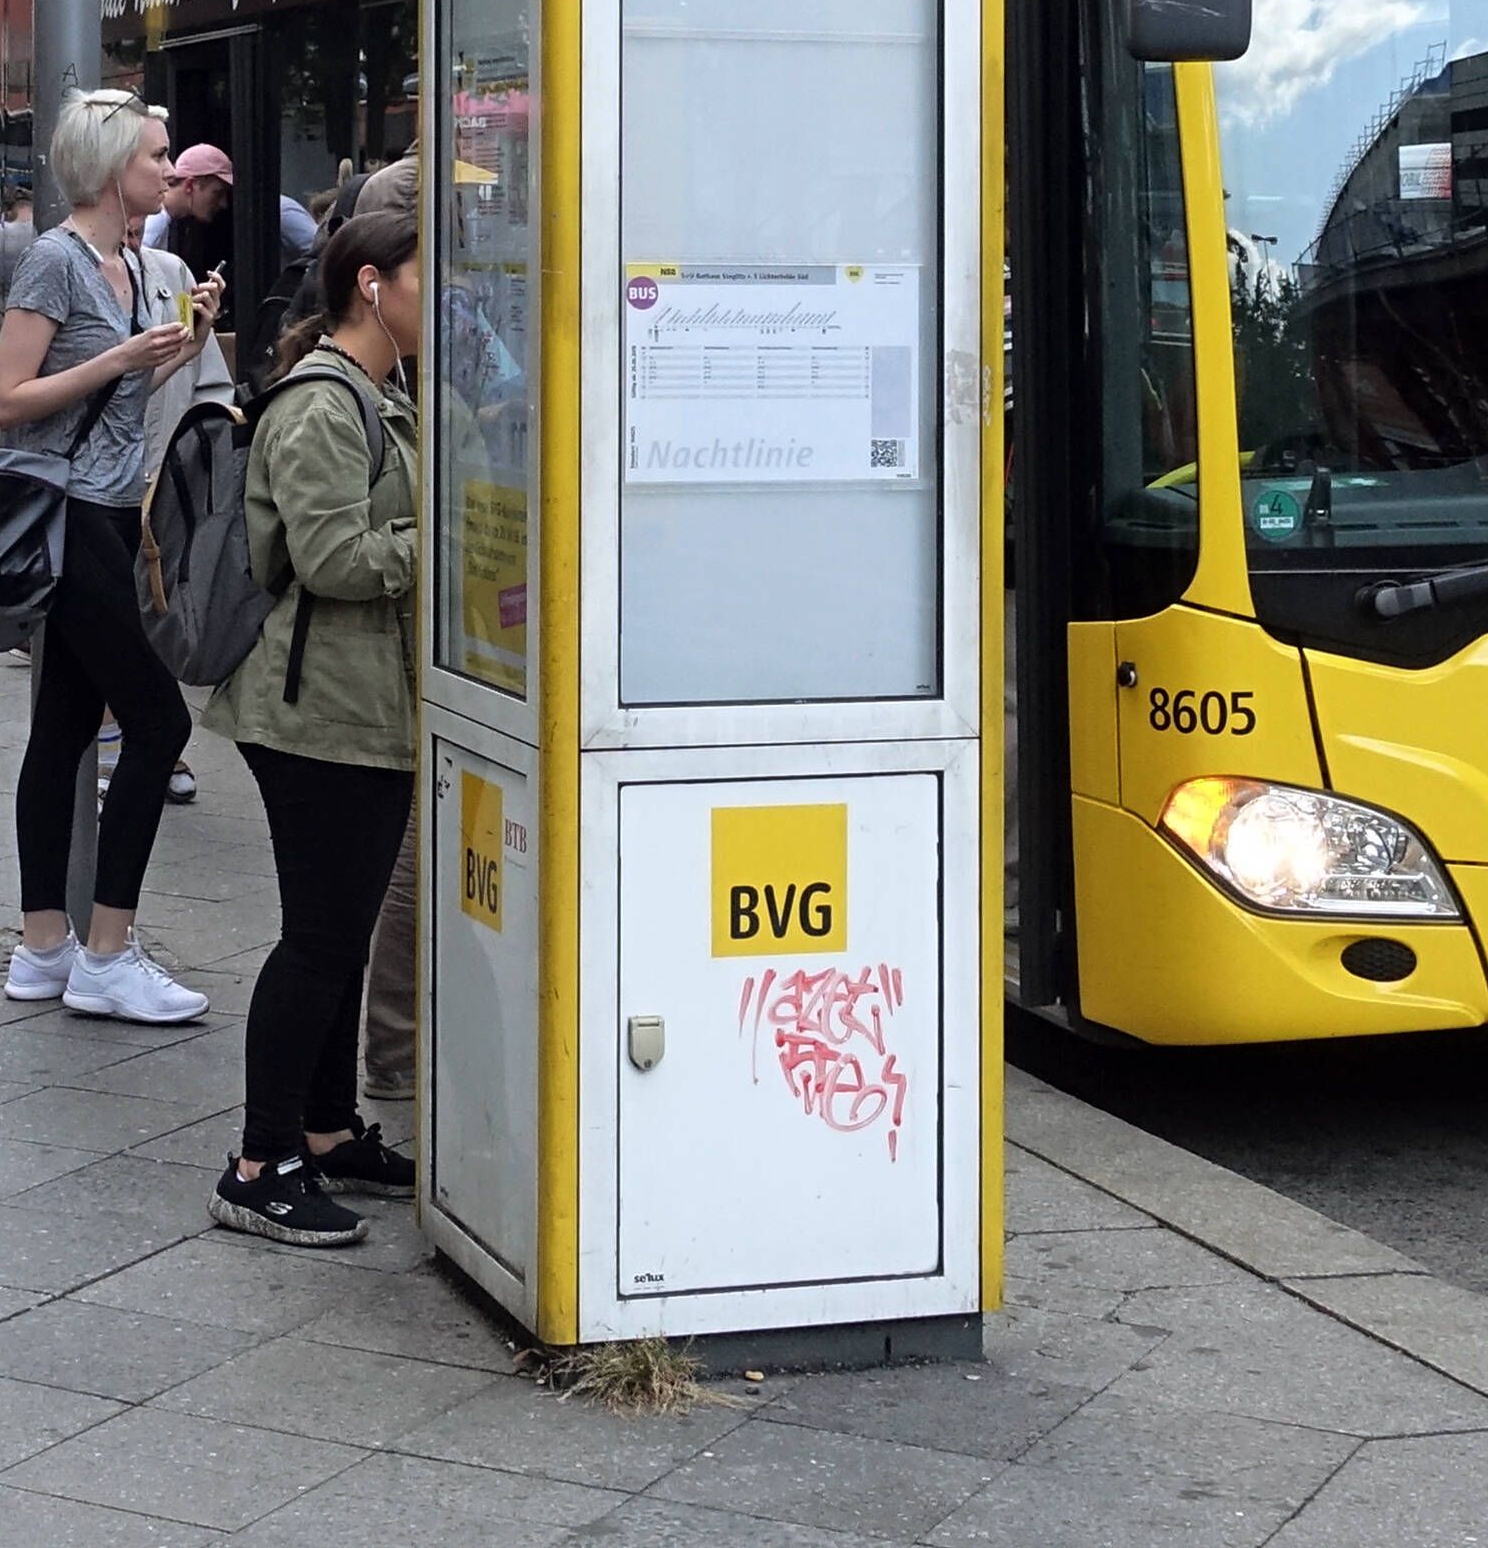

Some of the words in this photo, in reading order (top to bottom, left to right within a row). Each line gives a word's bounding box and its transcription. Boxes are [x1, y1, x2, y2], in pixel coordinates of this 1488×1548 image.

[628, 287, 657, 300] BUS
[646, 438, 814, 470] Nachtlinie
[1270, 494, 1283, 514] 4
[1149, 687, 1256, 736] 8605
[466, 848, 498, 914] BVG
[730, 882, 833, 940] BVG
